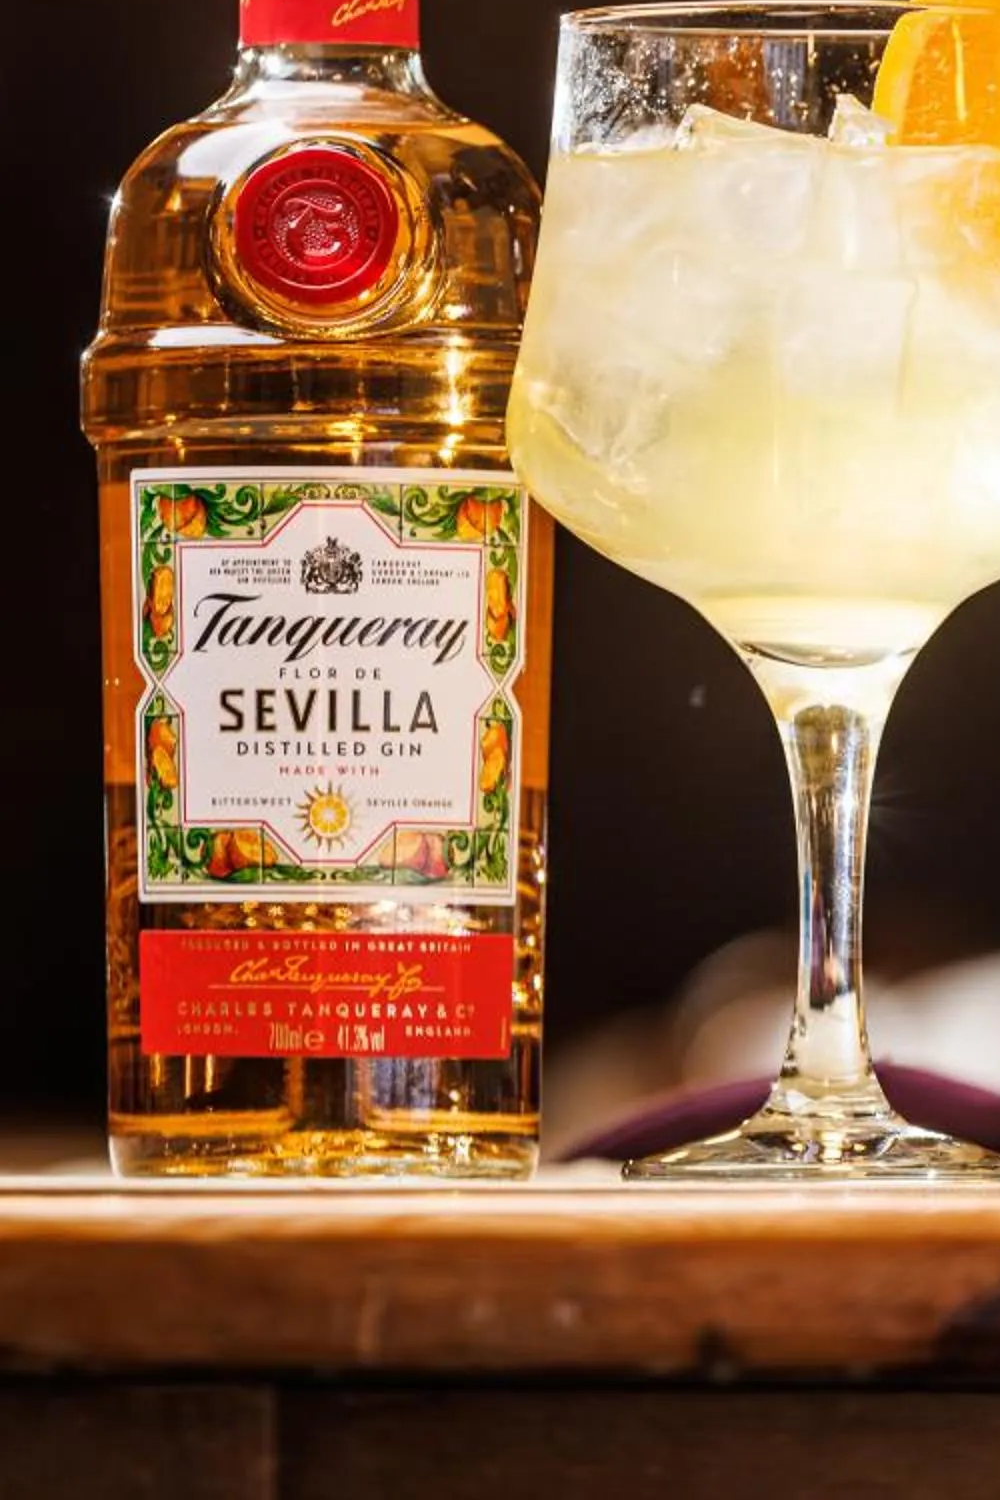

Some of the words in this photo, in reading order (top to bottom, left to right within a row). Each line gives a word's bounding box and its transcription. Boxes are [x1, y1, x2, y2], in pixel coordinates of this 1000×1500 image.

[192, 593, 470, 666] Tanqueray
[279, 667, 338, 680] FLOR
[355, 668, 382, 681] DE
[218, 688, 439, 734] SEVILLA
[236, 741, 367, 757] DISTILLED
[381, 741, 423, 757] GIN
[280, 766, 326, 776] MADE
[338, 766, 380, 777] WITH
[344, 942, 360, 953] IN
[367, 942, 414, 952] GREAT
[177, 1001, 273, 1017] CHARLES
[288, 1002, 428, 1018] TANQUERAY
[437, 1004, 447, 1019] &
